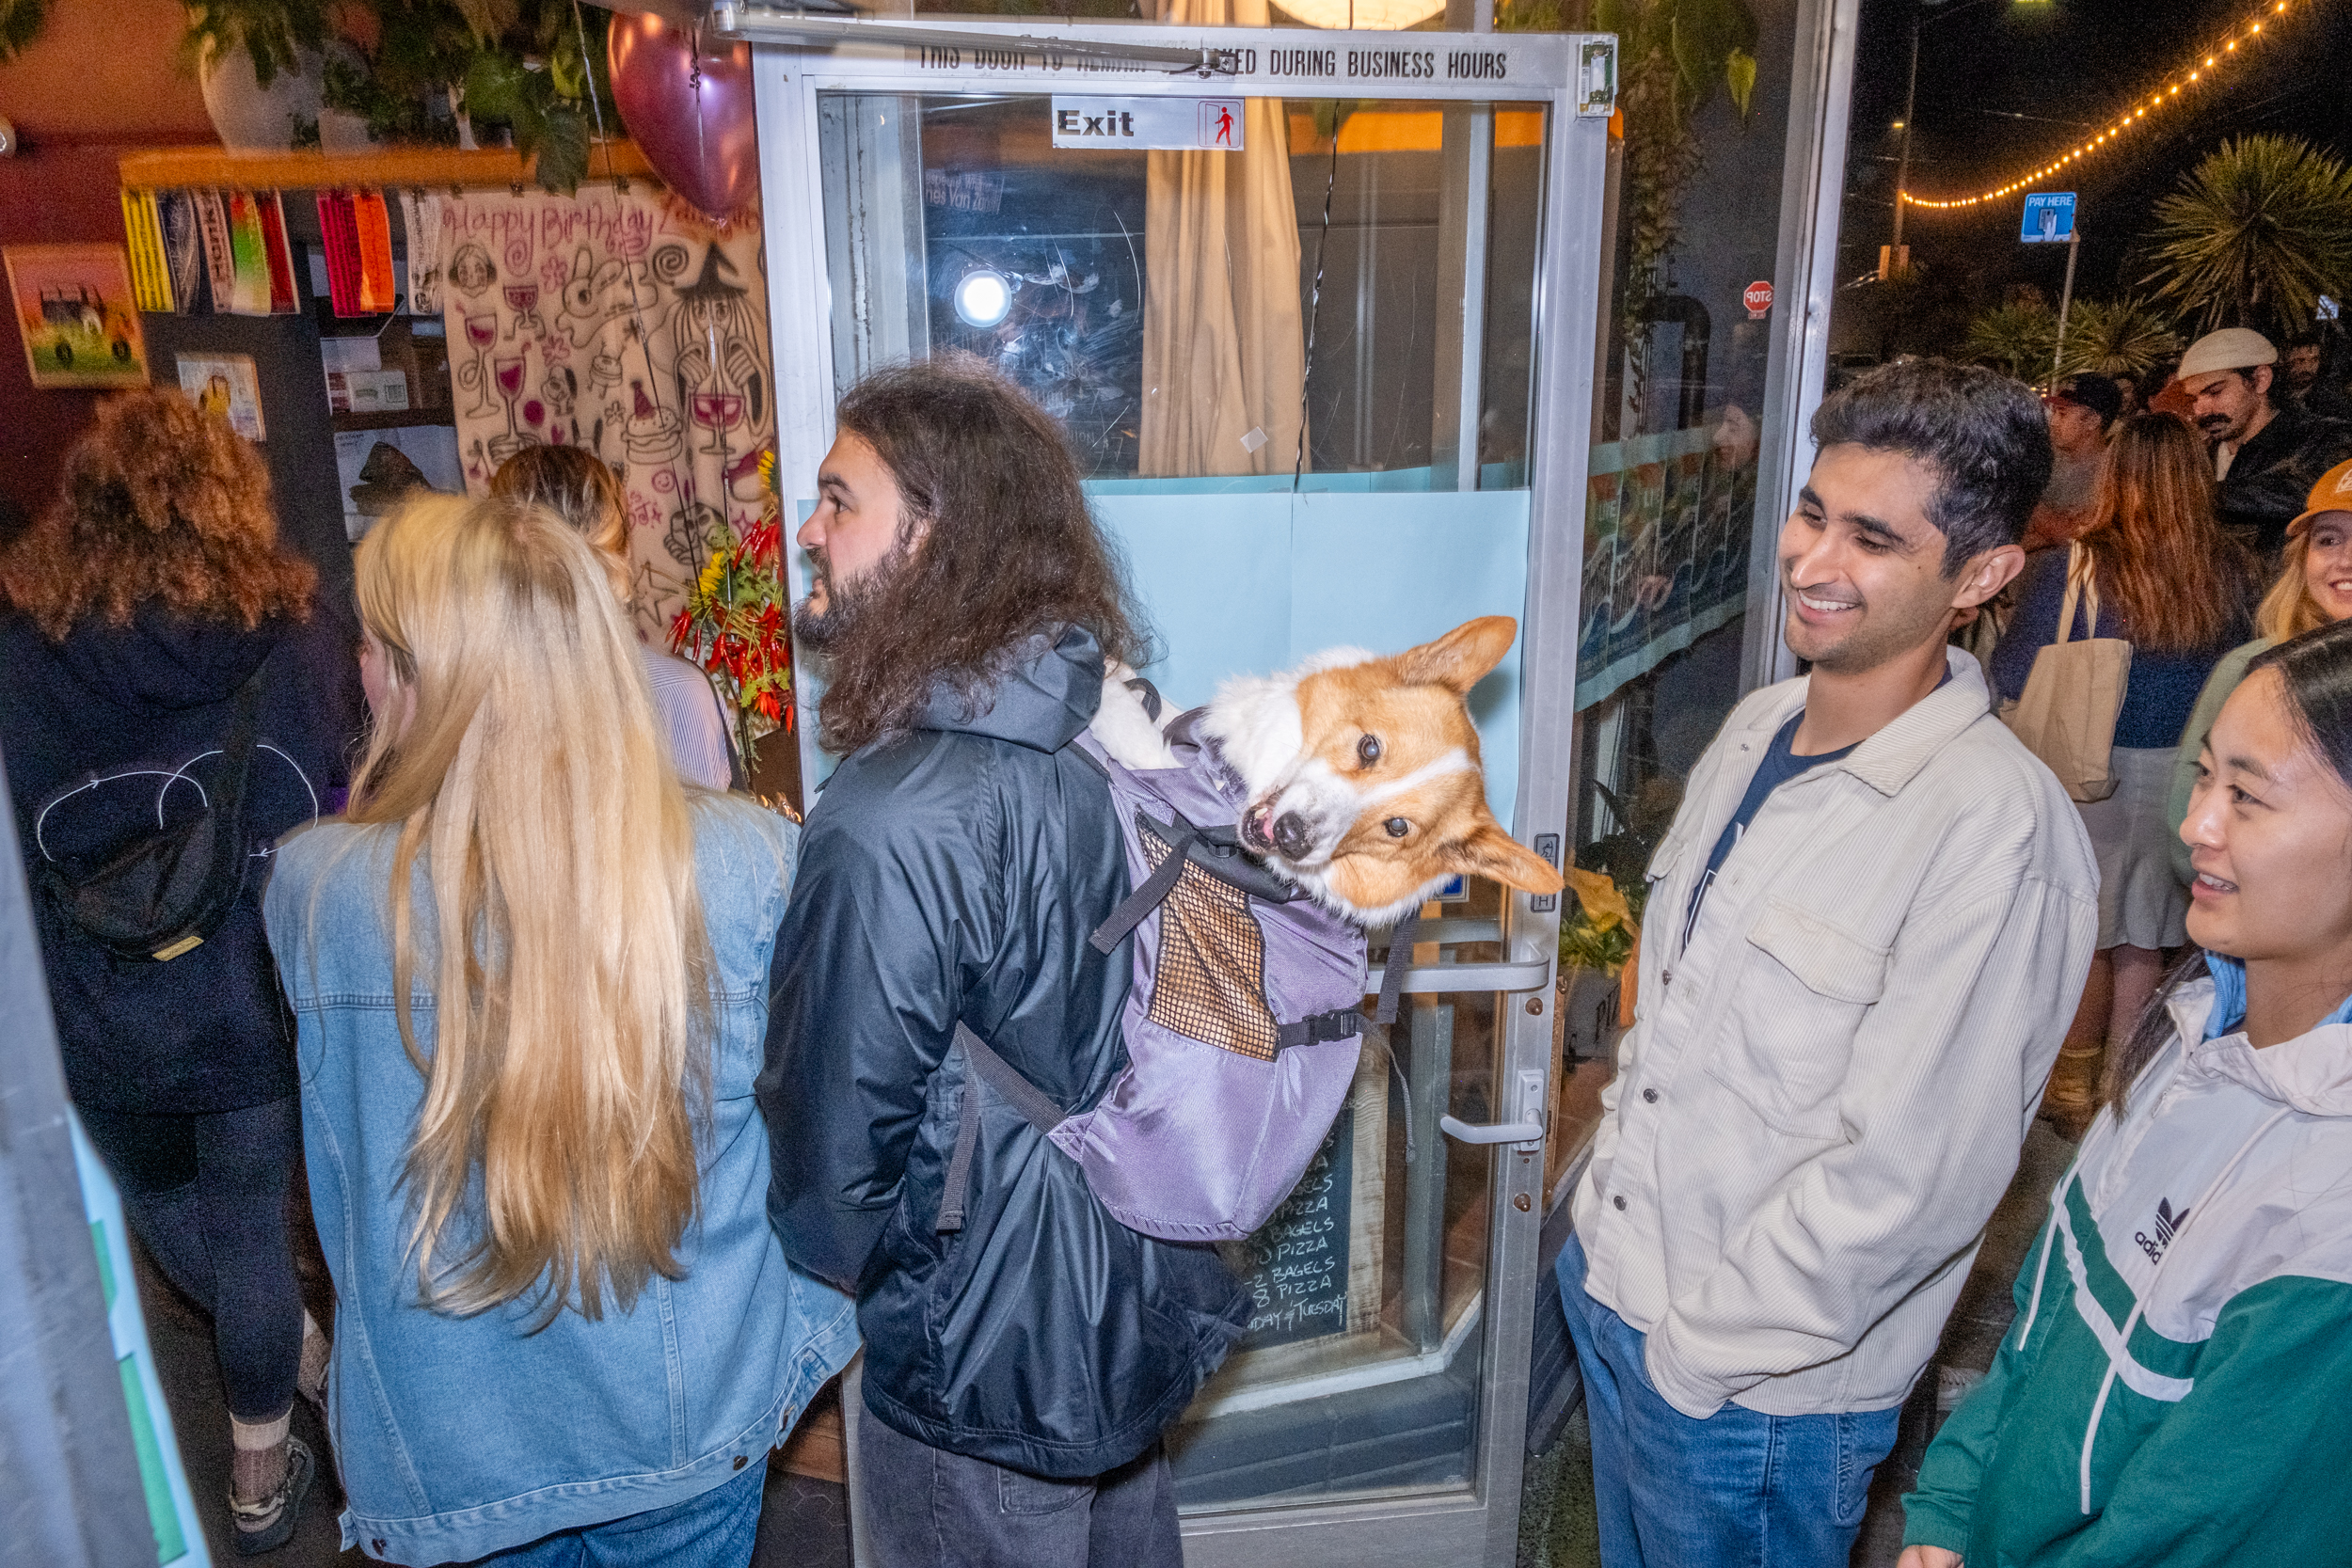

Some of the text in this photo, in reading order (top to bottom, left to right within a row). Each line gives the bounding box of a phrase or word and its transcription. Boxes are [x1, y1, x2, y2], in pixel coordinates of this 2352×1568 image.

[1269, 50, 1336, 77] DURING
[1347, 52, 1435, 79] BUSINESS
[1448, 53, 1507, 79] HOURS
[1057, 109, 1136, 137] Exit
[2028, 196, 2073, 207] PAY HERE
[443, 204, 534, 254] Happy
[542, 201, 653, 254] Birthday
[1280, 1196, 1328, 1220] PIZZA
[1270, 1216, 1335, 1243] BAGELS
[1278, 1236, 1328, 1261] PIZZA
[2135, 1231, 2163, 1266] adid
[1273, 1257, 1336, 1285] BAGELS
[1277, 1275, 1332, 1300] PIZZA
